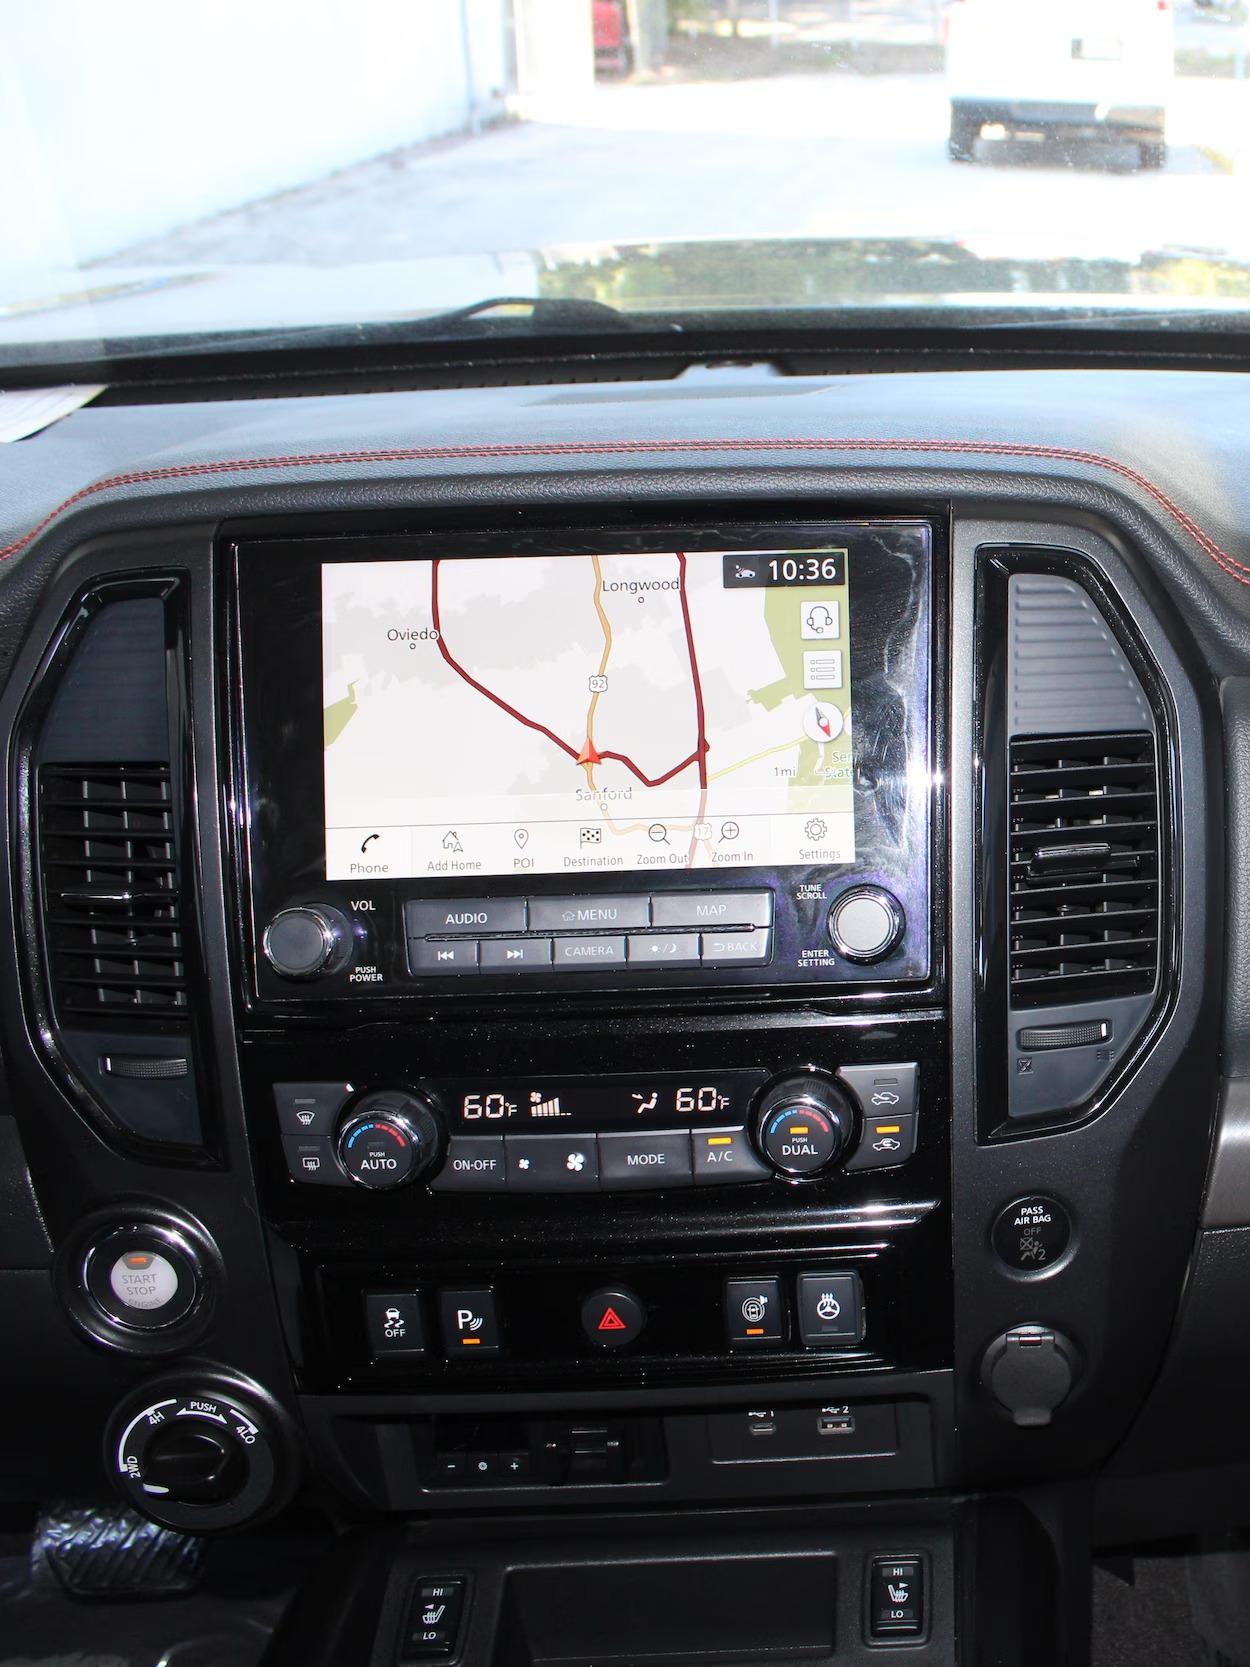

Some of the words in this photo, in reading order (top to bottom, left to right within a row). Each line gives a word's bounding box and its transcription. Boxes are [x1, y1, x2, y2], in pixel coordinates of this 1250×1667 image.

[768, 558, 837, 581] 10:36
[602, 577, 680, 595] Longwood
[387, 627, 438, 641] Oviedo
[591, 679, 605, 689] 92
[773, 766, 796, 777] 1mi
[575, 786, 632, 802] Sanford
[636, 853, 666, 866] Zoom
[669, 852, 688, 864] Out
[711, 851, 740, 863] Zoom
[743, 850, 753, 862] In
[798, 847, 841, 861] Settings
[427, 860, 449, 872] Add
[451, 859, 482, 871] Home
[513, 858, 534, 869] POI
[563, 855, 624, 868] Destination
[350, 863, 389, 874] Phone
[799, 883, 822, 893] TUNE
[796, 891, 827, 900] SCROLL
[350, 900, 376, 912] VOL
[696, 904, 727, 917] MAP
[445, 912, 488, 925] AUDIO
[577, 909, 618, 921] MENU
[564, 945, 614, 957] CAMERA
[727, 941, 758, 952] BACK
[801, 949, 829, 958] ENTER
[797, 957, 835, 967] SETTING
[355, 966, 377, 975] PUSH
[349, 973, 384, 983] POWER
[791, 1136, 808, 1144] PUSH
[369, 1150, 386, 1158] PUSH
[782, 1144, 819, 1156] DUAL
[627, 1153, 665, 1166] MODE
[706, 1150, 733, 1163] A/C
[360, 1158, 397, 1170] AUTO
[1021, 1206, 1044, 1215] PASS
[1014, 1217, 1030, 1225] AIR
[1032, 1214, 1051, 1224] BAG
[1023, 1227, 1041, 1236] OFF
[121, 1273, 157, 1285] START
[126, 1285, 156, 1296] STOP
[384, 1328, 406, 1338] OFF
[190, 1401, 217, 1413] PUSH
[842, 1405, 850, 1414] 2
[149, 1411, 166, 1425] 4H
[235, 1425, 256, 1445] 4LO
[126, 1455, 142, 1479] 2WD
[893, 1568, 903, 1576] HI
[433, 1588, 443, 1596] HI
[891, 1610, 904, 1618] LO
[423, 1632, 436, 1640] LO
